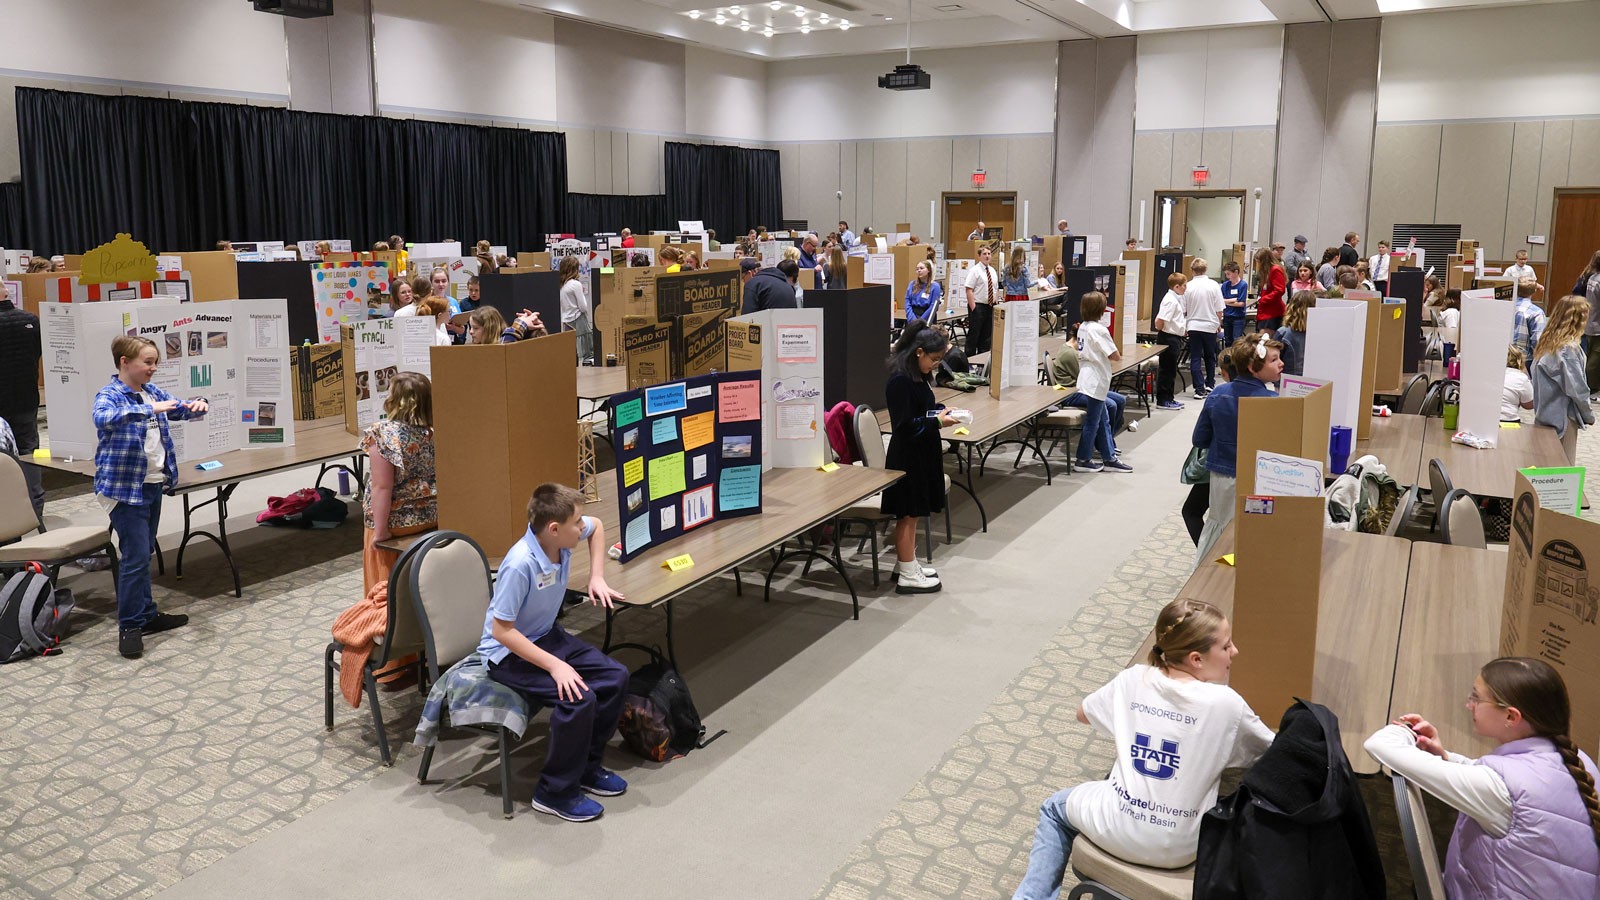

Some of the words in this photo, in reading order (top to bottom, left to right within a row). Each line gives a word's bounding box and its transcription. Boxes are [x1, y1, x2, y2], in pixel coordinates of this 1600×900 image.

[553, 248, 564, 257] THE
[100, 252, 146, 276] Popcorn
[684, 286, 715, 302] BOARD
[716, 284, 728, 297] KIT
[702, 299, 721, 310] HEADER
[173, 316, 192, 328] Ants
[195, 314, 232, 323] Advance!
[140, 324, 167, 335] Angry
[729, 330, 746, 340] PROJECT
[626, 333, 654, 347] BOARD
[655, 328, 669, 338] KIT
[688, 329, 716, 358] BOARD
[317, 357, 344, 379] BOAR
[1274, 464, 1305, 478] Question
[1130, 702, 1183, 723] SPONSORED
[1184, 714, 1198, 726] BY
[1130, 744, 1181, 770] STATE
[1149, 814, 1177, 829] Basin
